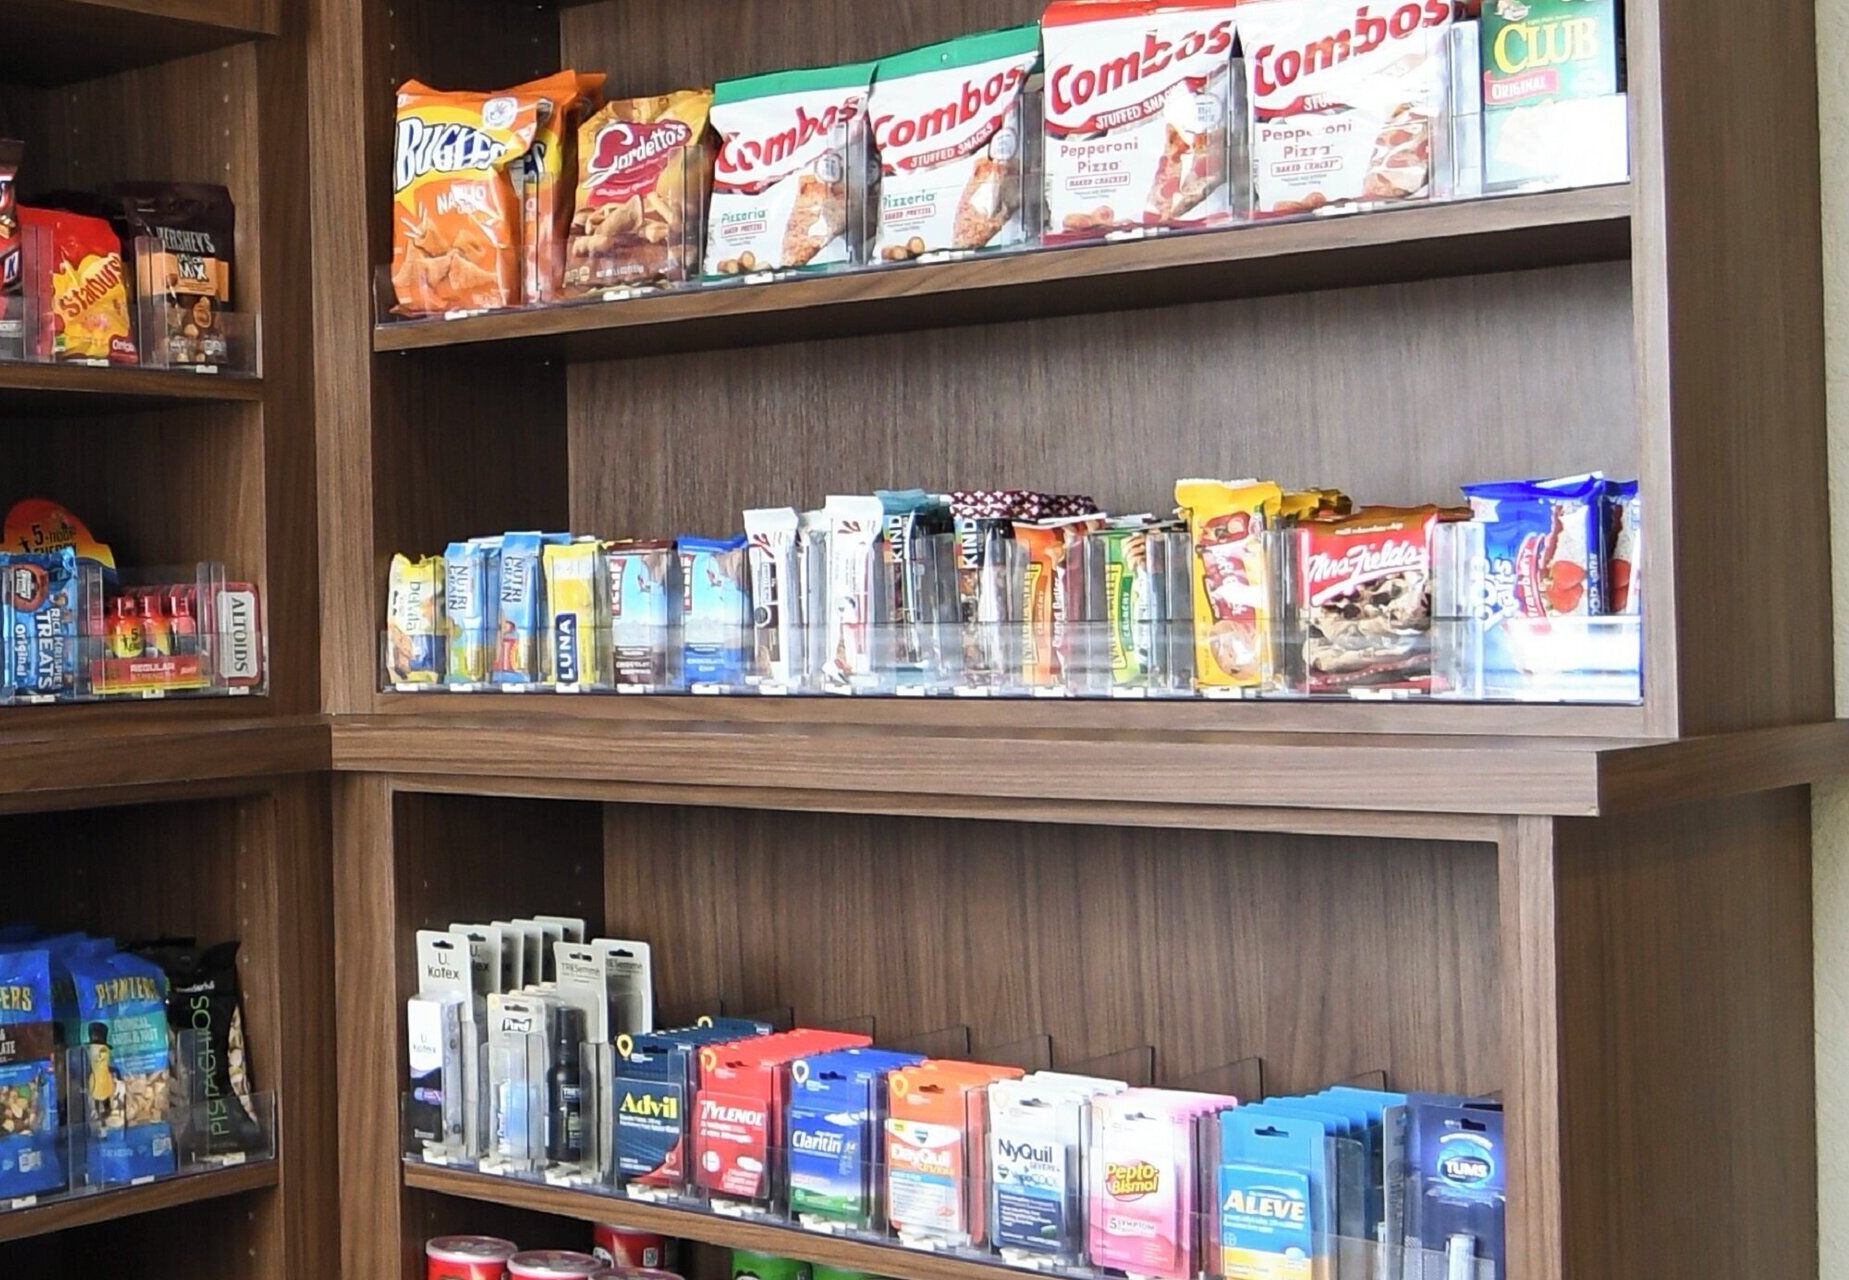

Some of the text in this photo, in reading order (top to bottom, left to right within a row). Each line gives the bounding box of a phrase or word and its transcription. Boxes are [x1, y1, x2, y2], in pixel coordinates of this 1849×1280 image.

[1493, 20, 1600, 76] CLUB
[1052, 21, 1232, 115] Combos
[1491, 78, 1546, 99] ORIGINAL
[871, 68, 1025, 151] Combos
[1095, 104, 1142, 129] STUFFED
[715, 96, 858, 173] Combos
[1060, 138, 1139, 159] Pepperoni
[910, 148, 953, 169] STUFFED
[1077, 159, 1120, 173] Pizza
[890, 514, 903, 564] KIND
[962, 518, 978, 570] KIND
[232, 597, 248, 673] ALTOIDS
[36, 609, 53, 690] TREATS
[560, 619, 574, 680] LUNA
[427, 965, 460, 980] Kotex
[189, 996, 229, 1136] PISTACHIOS
[619, 1092, 679, 1120] Advil
[701, 1099, 765, 1127] TYLENOL
[792, 1130, 842, 1153] Claritin
[997, 1139, 1053, 1163] NyQuil
[1443, 1159, 1490, 1178] TUMS
[1110, 1174, 1160, 1196] Bismol
[1222, 1189, 1306, 1221] ALEVE
